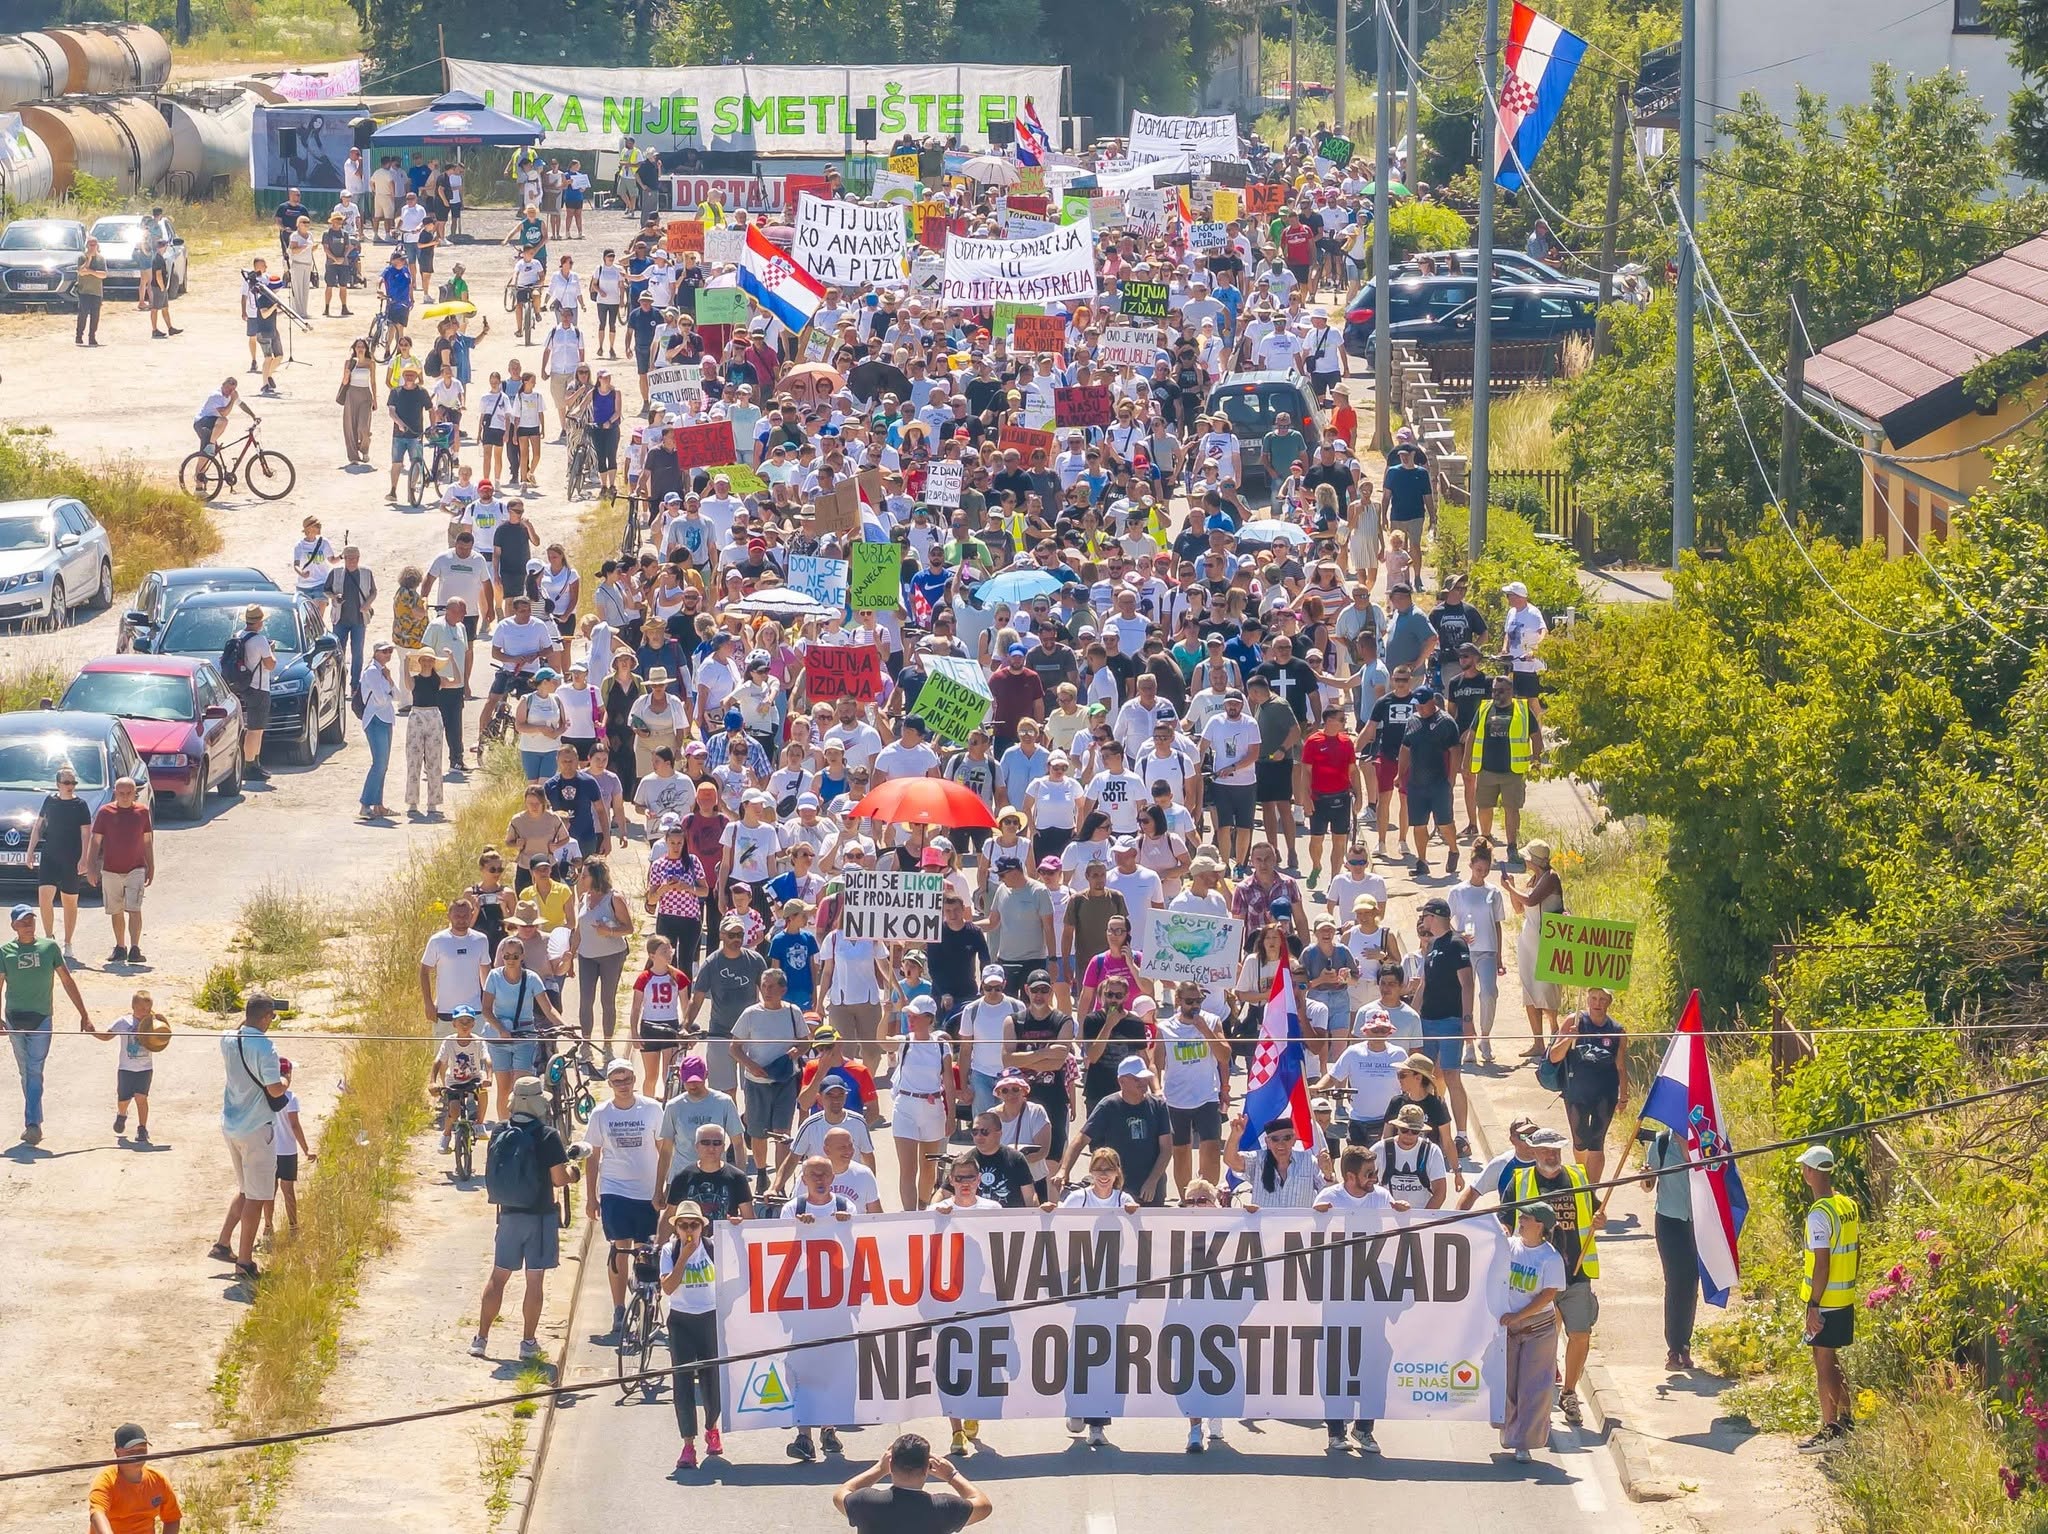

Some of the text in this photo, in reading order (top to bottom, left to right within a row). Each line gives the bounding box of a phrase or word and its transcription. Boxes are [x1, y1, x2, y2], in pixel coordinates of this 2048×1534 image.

[602, 96, 699, 135] NIJE
[1324, 137, 1350, 154] VODA
[677, 180, 763, 207] DOSTA
[1253, 186, 1278, 205] NE
[1131, 206, 1155, 222] LIKA
[1190, 221, 1224, 232] EKOCID
[799, 224, 819, 248] KO
[827, 231, 901, 256] ANANAS
[1009, 229, 1083, 260] SANACIJA
[1190, 234, 1226, 248] VELEBITOM
[807, 252, 837, 278] NA
[1001, 262, 1023, 278] ILI
[942, 269, 1094, 300] POLITIČKA KASTRACIJA
[1122, 301, 1166, 317] IZDAJA
[1106, 330, 1155, 344] OVO JE VAMA
[927, 465, 963, 478] IZDANI
[790, 556, 846, 577] DOM SE
[862, 552, 894, 564] VODA
[806, 574, 825, 588] NE
[856, 595, 899, 607] SLOBODA
[809, 675, 872, 698] IZDAJA
[929, 674, 986, 714] PRIRODA
[934, 697, 969, 722] NEMA
[1103, 781, 1127, 792] JUST
[1102, 791, 1116, 802] DO
[881, 874, 899, 890] SE
[903, 875, 944, 891] LIKOM
[844, 890, 943, 910] NE PRODAJEM JE
[845, 911, 940, 941] NIKOM
[1545, 920, 1634, 950] SVE ANALIZE
[1549, 947, 1575, 976] NA
[652, 981, 673, 1004] 19
[1390, 1183, 1423, 1192] adidas
[747, 1230, 1472, 1314] IZDAJU VAM LIKA NIKAD
[1031, 1323, 1363, 1397] OPROSTITI!
[1393, 1361, 1449, 1374] GOSPIĆ
[1397, 1375, 1449, 1388] JE NAŠ
[1412, 1391, 1448, 1402] DOM
